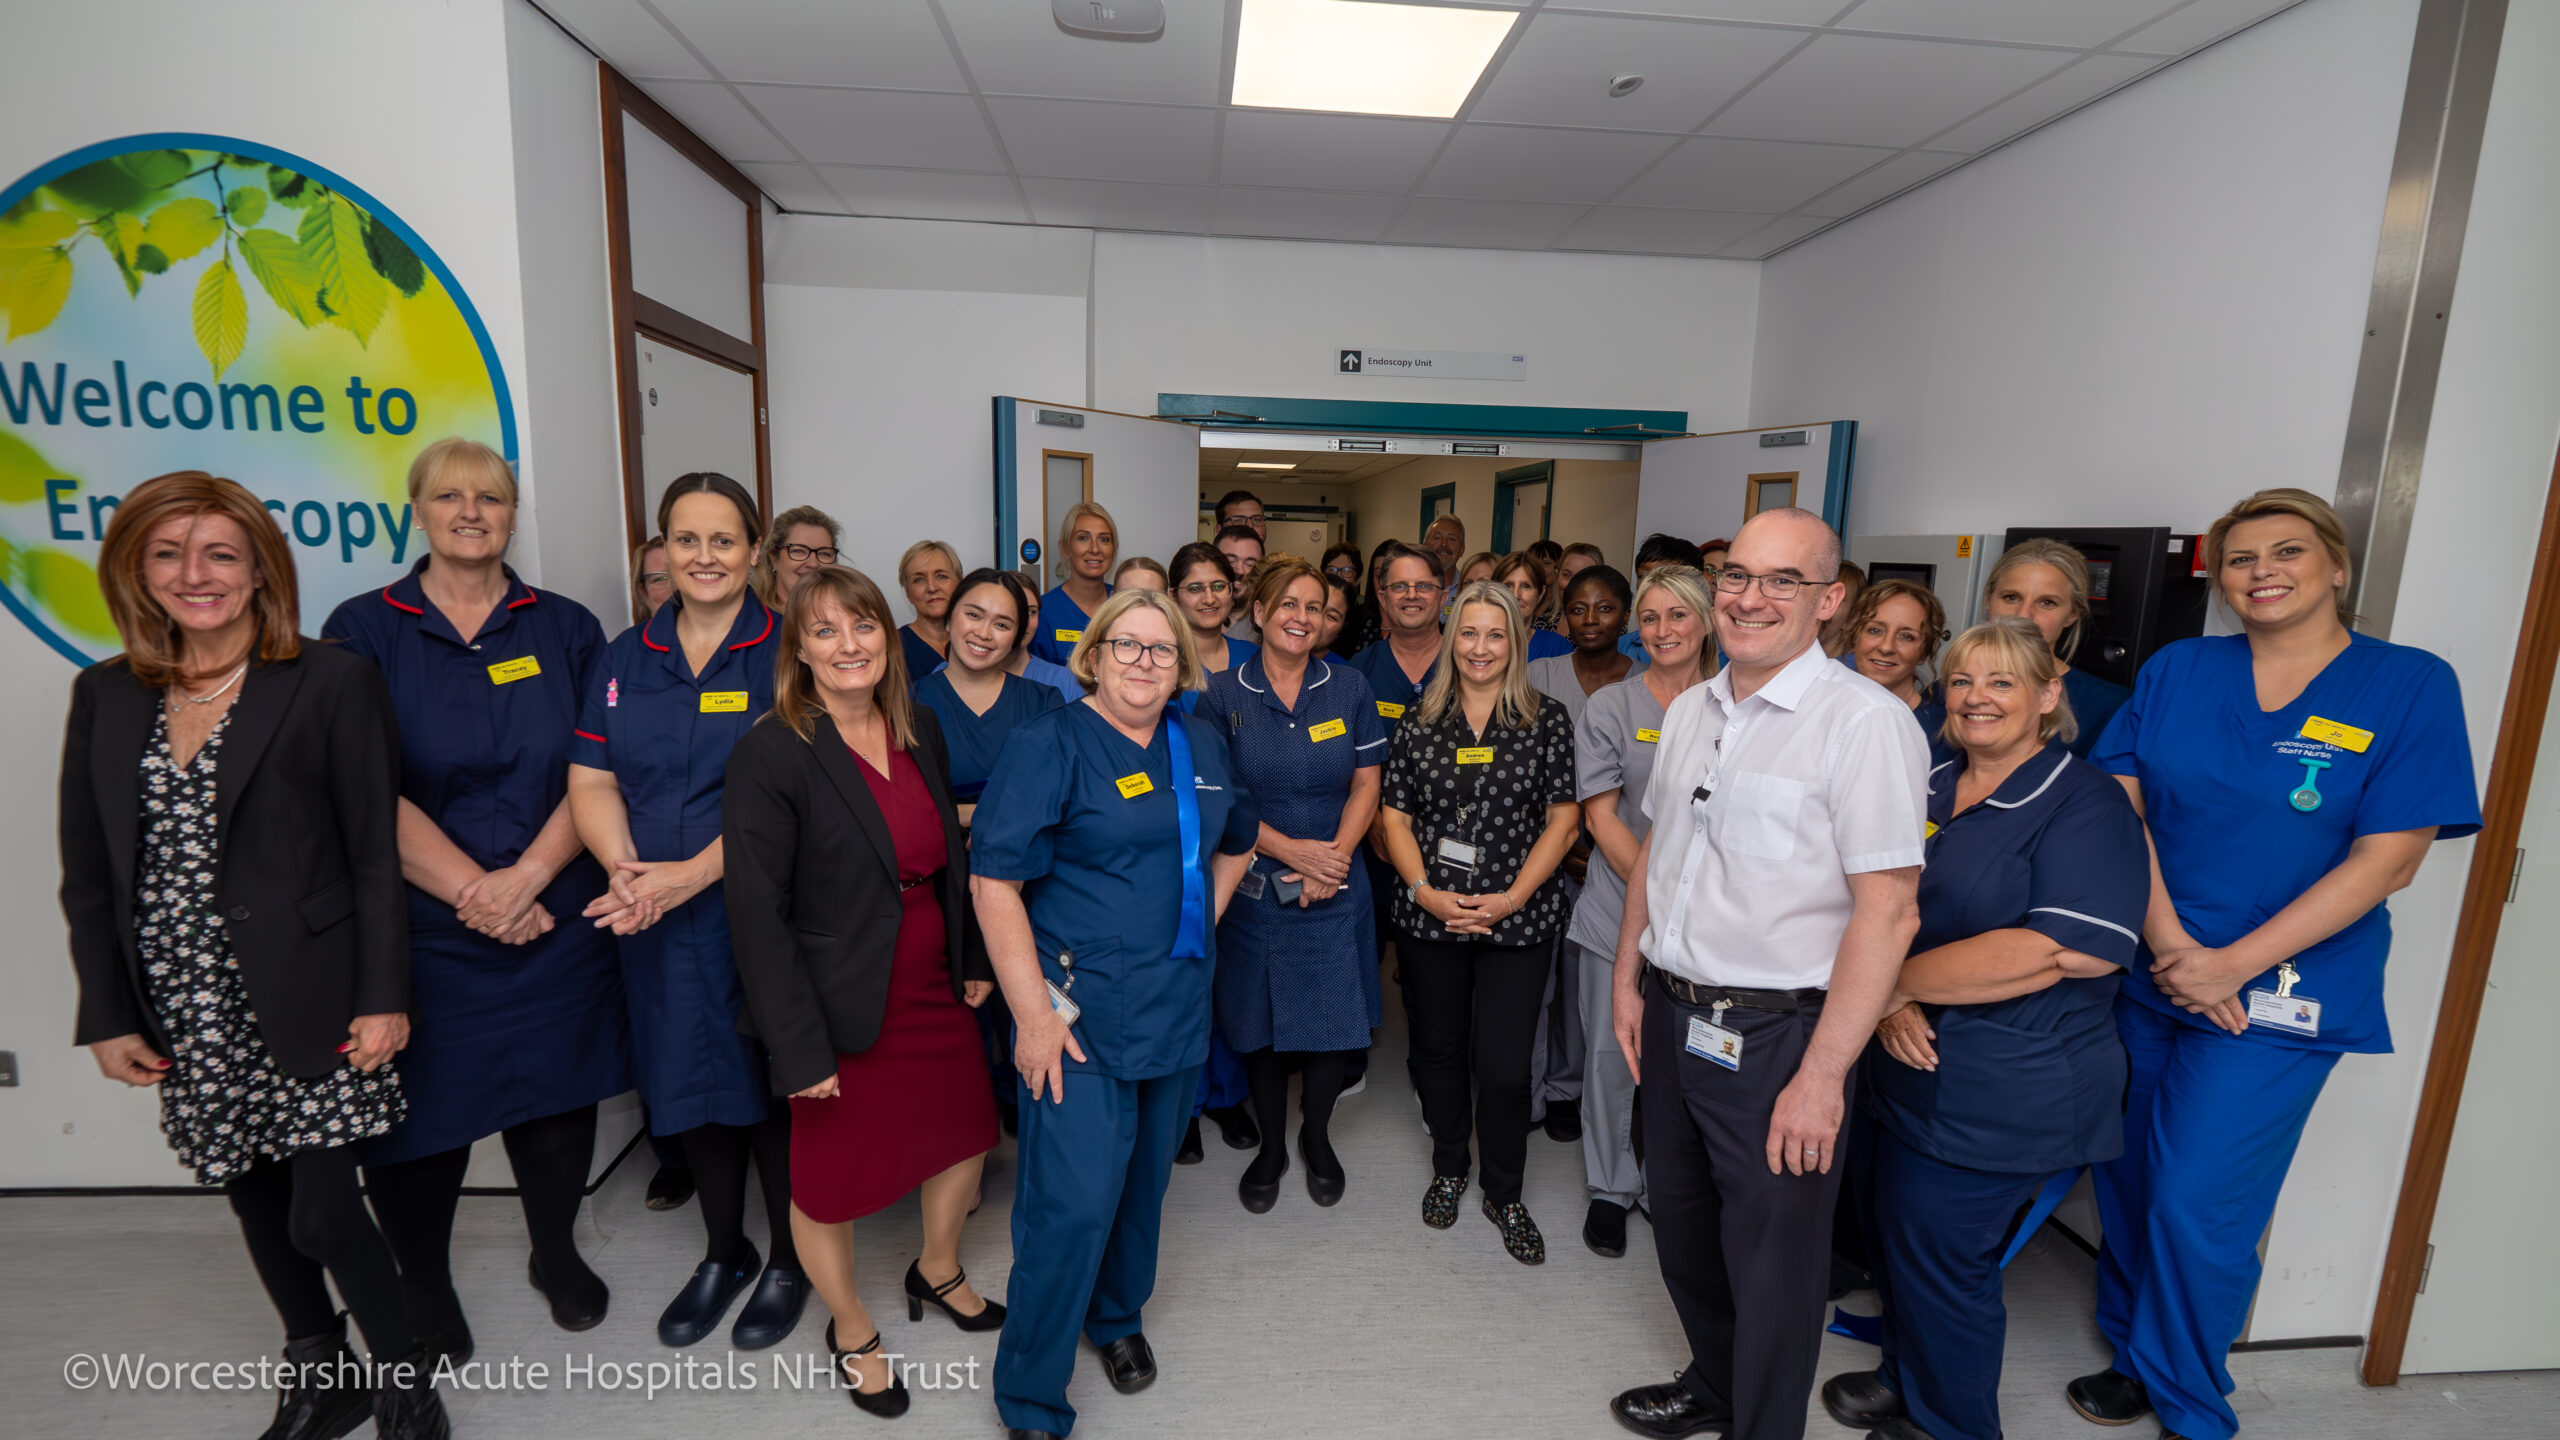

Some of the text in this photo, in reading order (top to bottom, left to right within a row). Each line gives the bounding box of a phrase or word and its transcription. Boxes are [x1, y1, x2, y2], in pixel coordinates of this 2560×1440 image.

[1367, 357, 1432, 368] Endoscopy Unit
[0, 360, 417, 436] Welcome to
[714, 698, 734, 706] Lydia
[2330, 730, 2343, 738] Jo
[2277, 747, 2332, 759] Staff Nurse
[1125, 780, 1145, 790] Deborah
